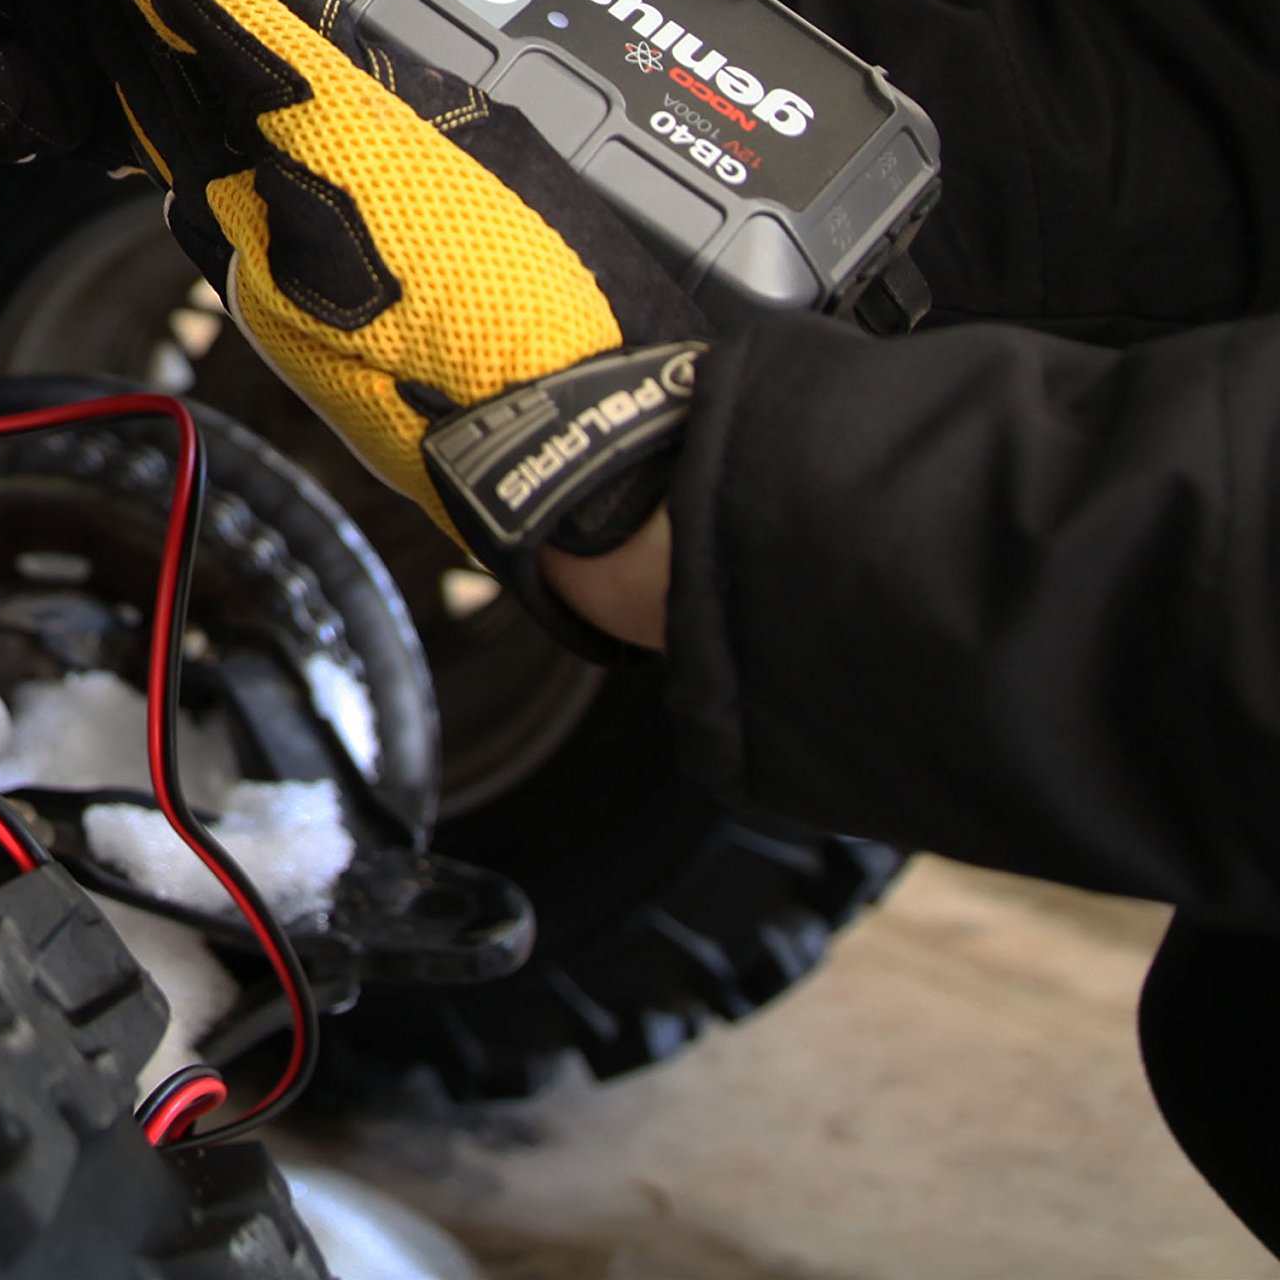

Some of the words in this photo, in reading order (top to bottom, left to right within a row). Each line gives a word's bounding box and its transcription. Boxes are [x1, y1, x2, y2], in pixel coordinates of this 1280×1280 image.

[663, 93, 721, 140] 1000A
[669, 67, 757, 132] NOCO
[650, 110, 747, 185] GB40
[495, 376, 667, 512] POLARIS
